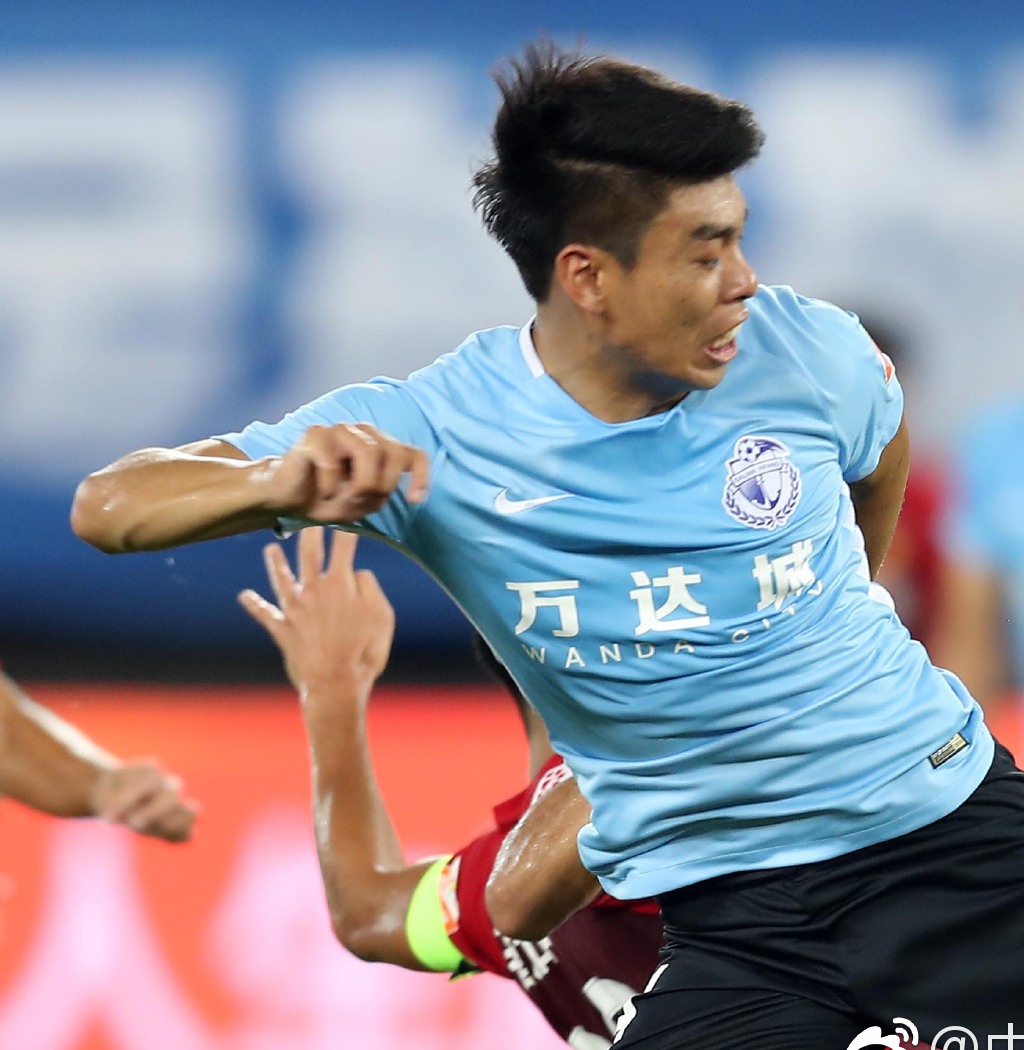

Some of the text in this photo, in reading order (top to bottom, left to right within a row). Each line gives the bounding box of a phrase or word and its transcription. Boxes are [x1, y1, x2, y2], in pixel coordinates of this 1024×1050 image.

[505, 539, 823, 637] 万达城
[521, 639, 696, 669] WANDA
